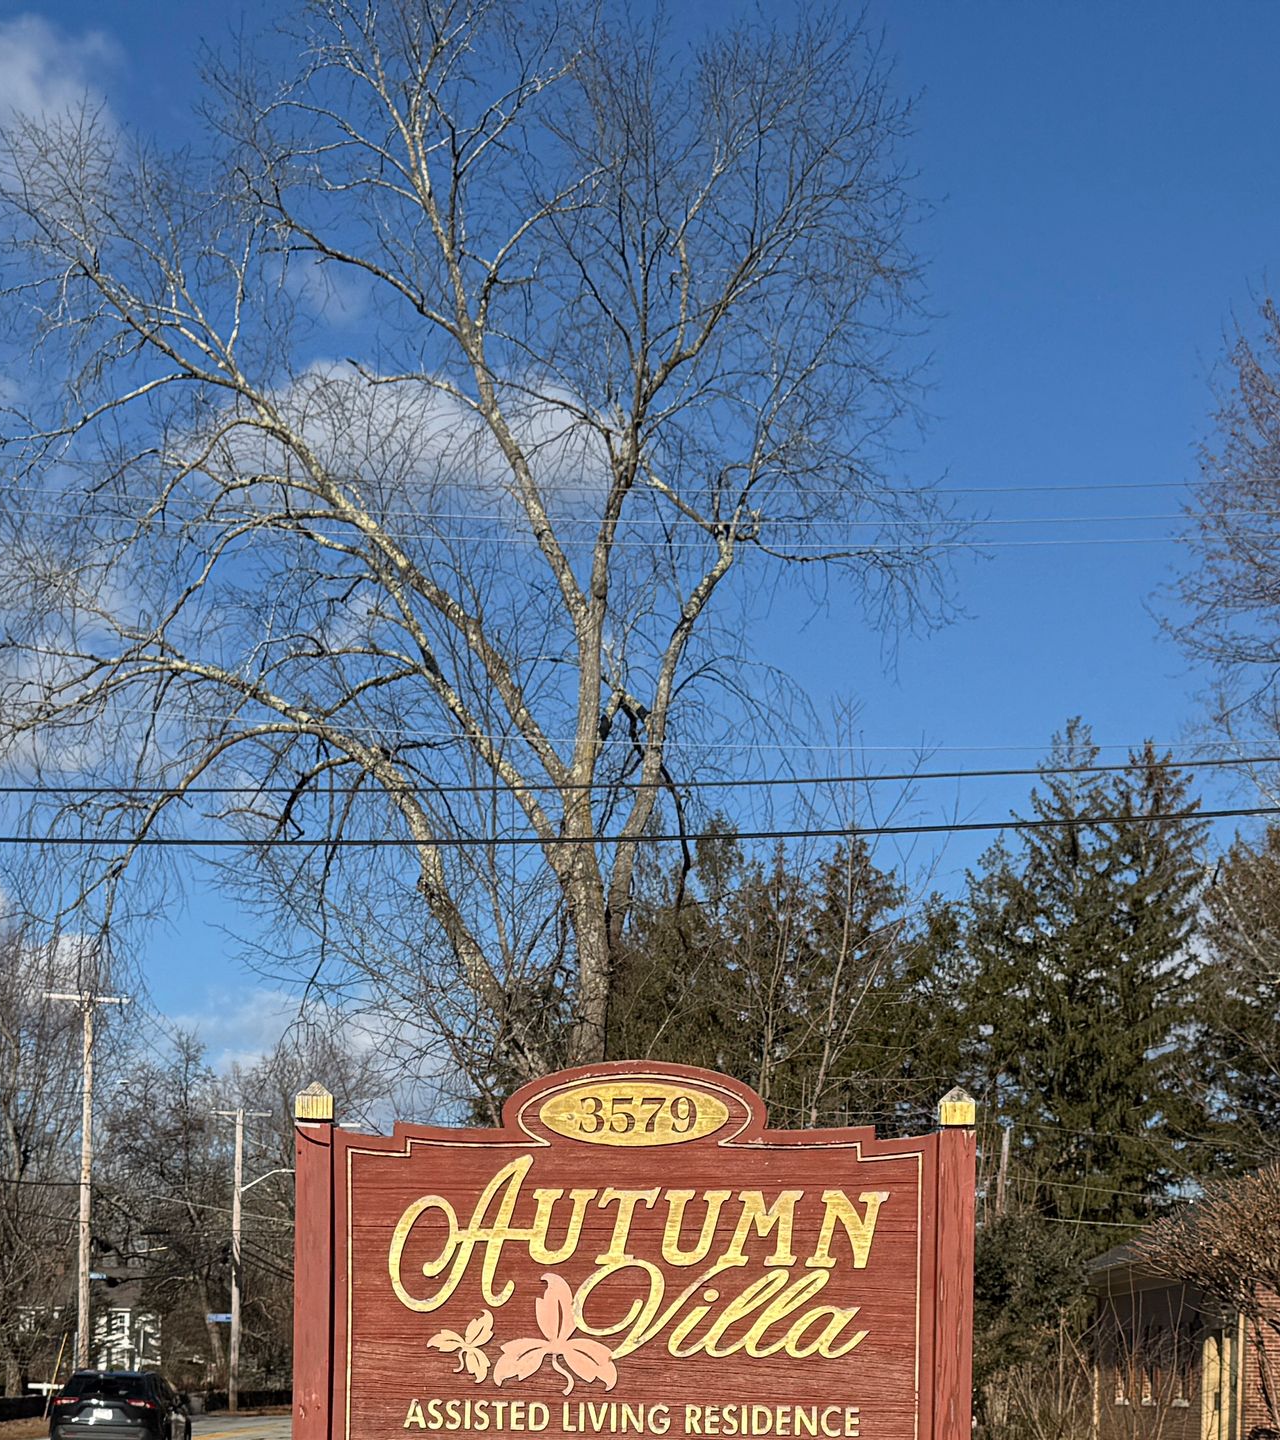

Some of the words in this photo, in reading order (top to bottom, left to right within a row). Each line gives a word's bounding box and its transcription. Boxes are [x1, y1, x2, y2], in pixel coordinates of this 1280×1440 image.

[578, 1096, 698, 1134] 3579
[388, 1153, 891, 1313] AUTUMN
[572, 1258, 871, 1360] Villa
[403, 1398, 550, 1433] ASSISTED
[562, 1402, 672, 1436] LIVING
[685, 1405, 861, 1439] RESIDENCE
